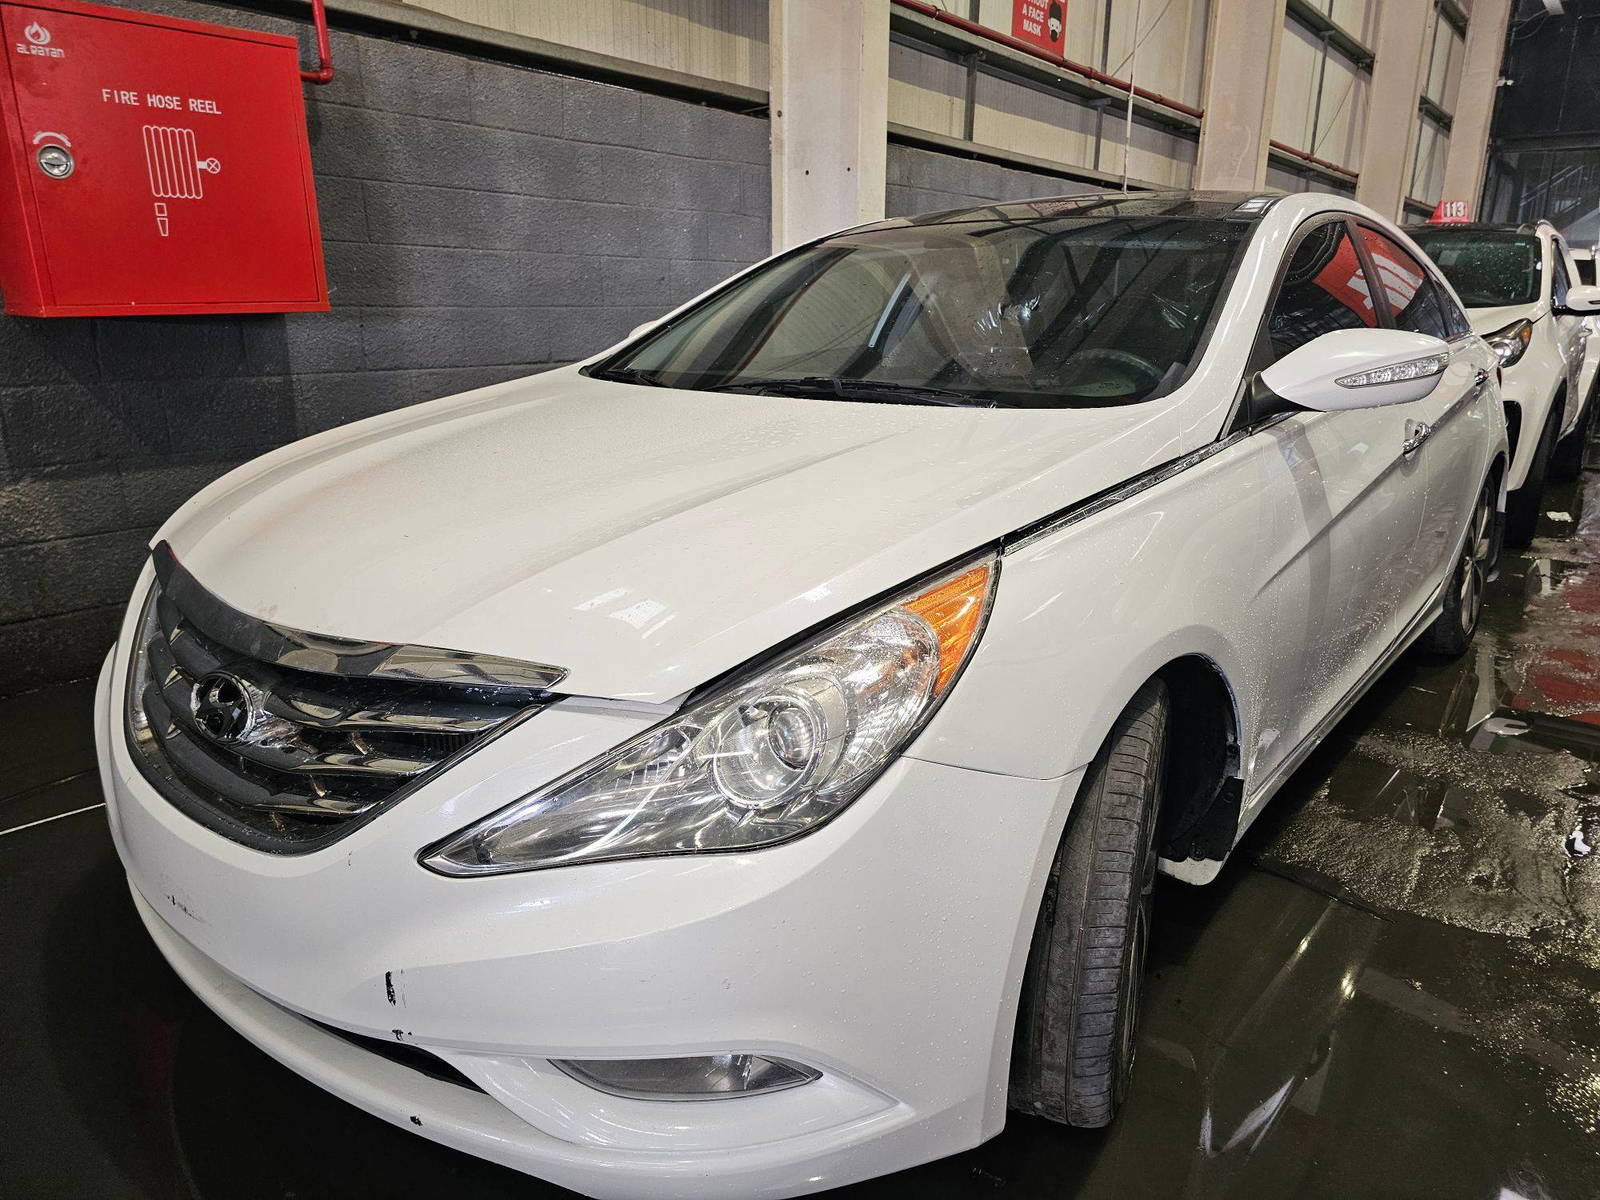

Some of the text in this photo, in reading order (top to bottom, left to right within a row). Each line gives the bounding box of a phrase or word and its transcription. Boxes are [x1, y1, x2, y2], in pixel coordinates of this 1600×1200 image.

[1022, 3, 1044, 22] A FACE
[1023, 19, 1041, 37] MASK
[102, 88, 222, 115] FIRE HOSE REEL
[1445, 201, 1465, 218] 113
